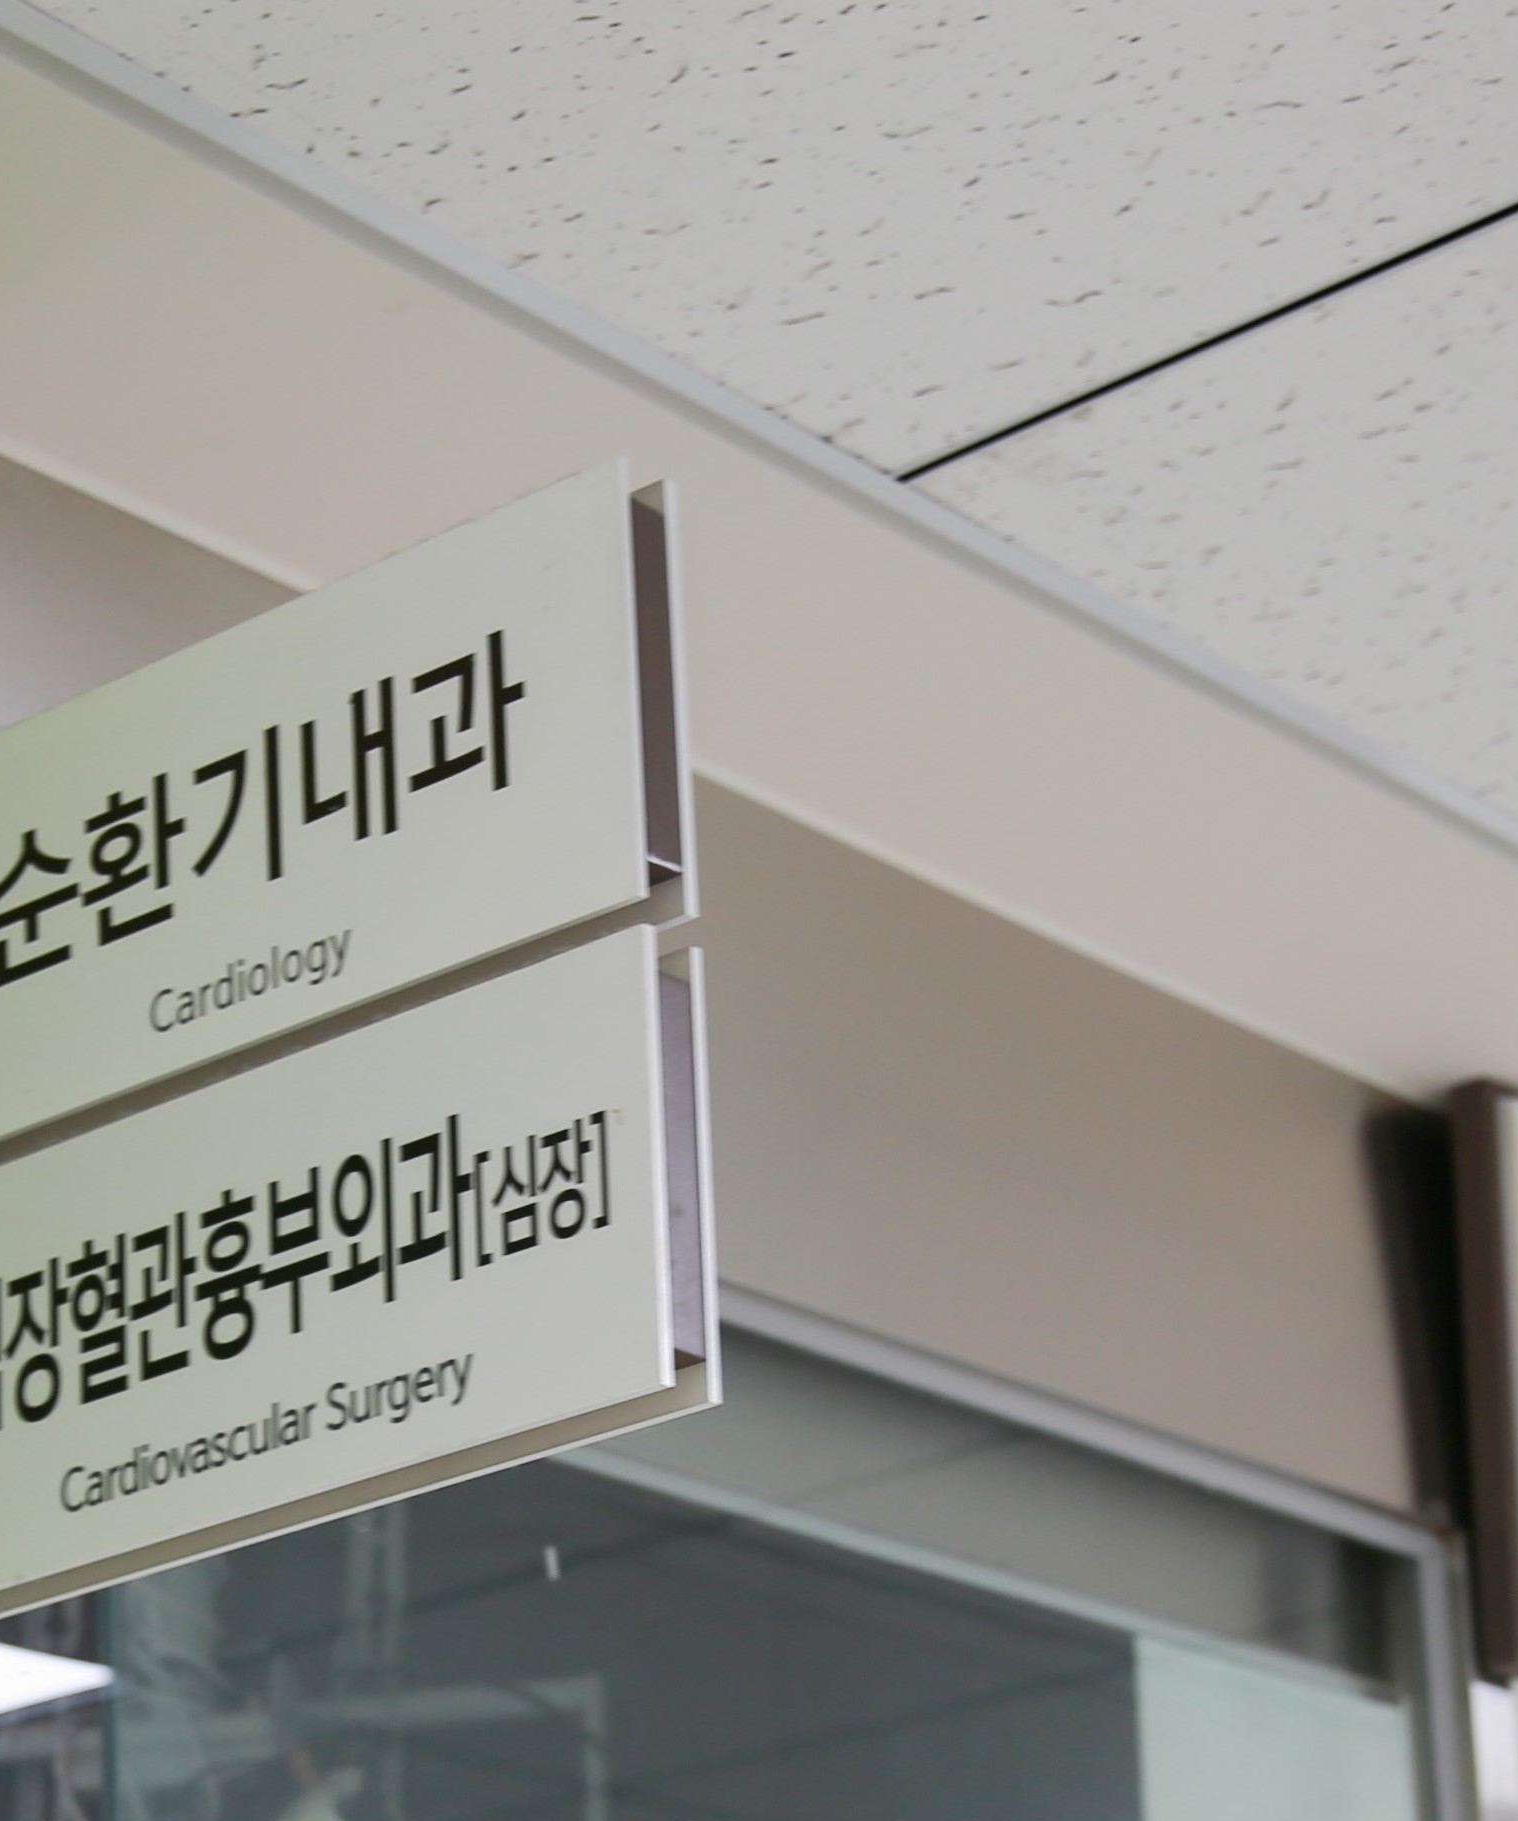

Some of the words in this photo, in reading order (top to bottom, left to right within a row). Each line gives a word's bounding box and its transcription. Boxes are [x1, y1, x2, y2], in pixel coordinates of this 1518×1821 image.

[149, 928, 351, 1034] Cardiology
[60, 1401, 317, 1513] Cardiovascular
[326, 1353, 474, 1431] Surgery
